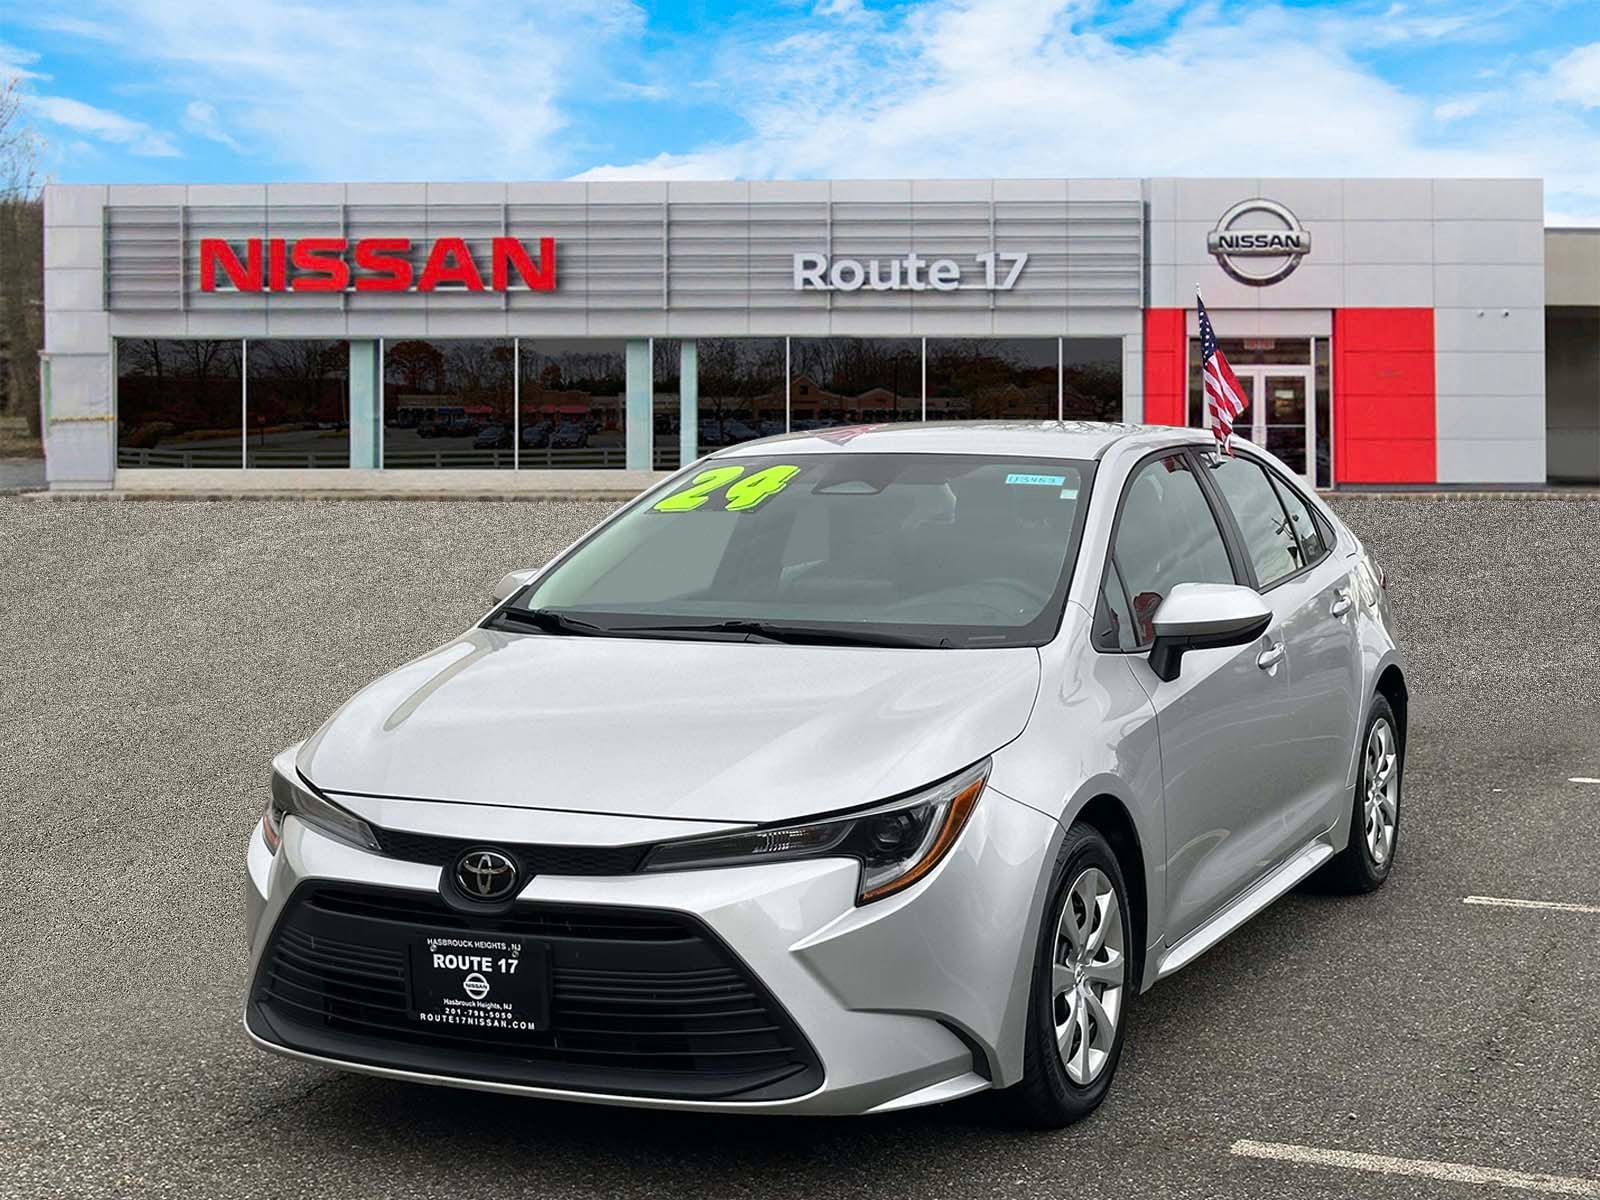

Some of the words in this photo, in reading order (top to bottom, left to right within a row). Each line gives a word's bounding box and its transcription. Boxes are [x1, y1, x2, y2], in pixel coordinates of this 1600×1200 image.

[1218, 234, 1300, 249] NISSAN
[200, 237, 555, 292] NISSAN
[793, 252, 961, 290] Route
[975, 251, 1029, 290] 17
[653, 464, 801, 512] 24
[427, 938, 474, 949] HASBROUCK
[511, 943, 521, 951] NJ
[433, 953, 493, 972] ROUTE
[498, 958, 519, 974] 17
[443, 998, 476, 1008] Hasbrouck
[503, 1003, 513, 1011] NJ
[420, 1013, 535, 1030] ROUTE17NISSAN.COM
